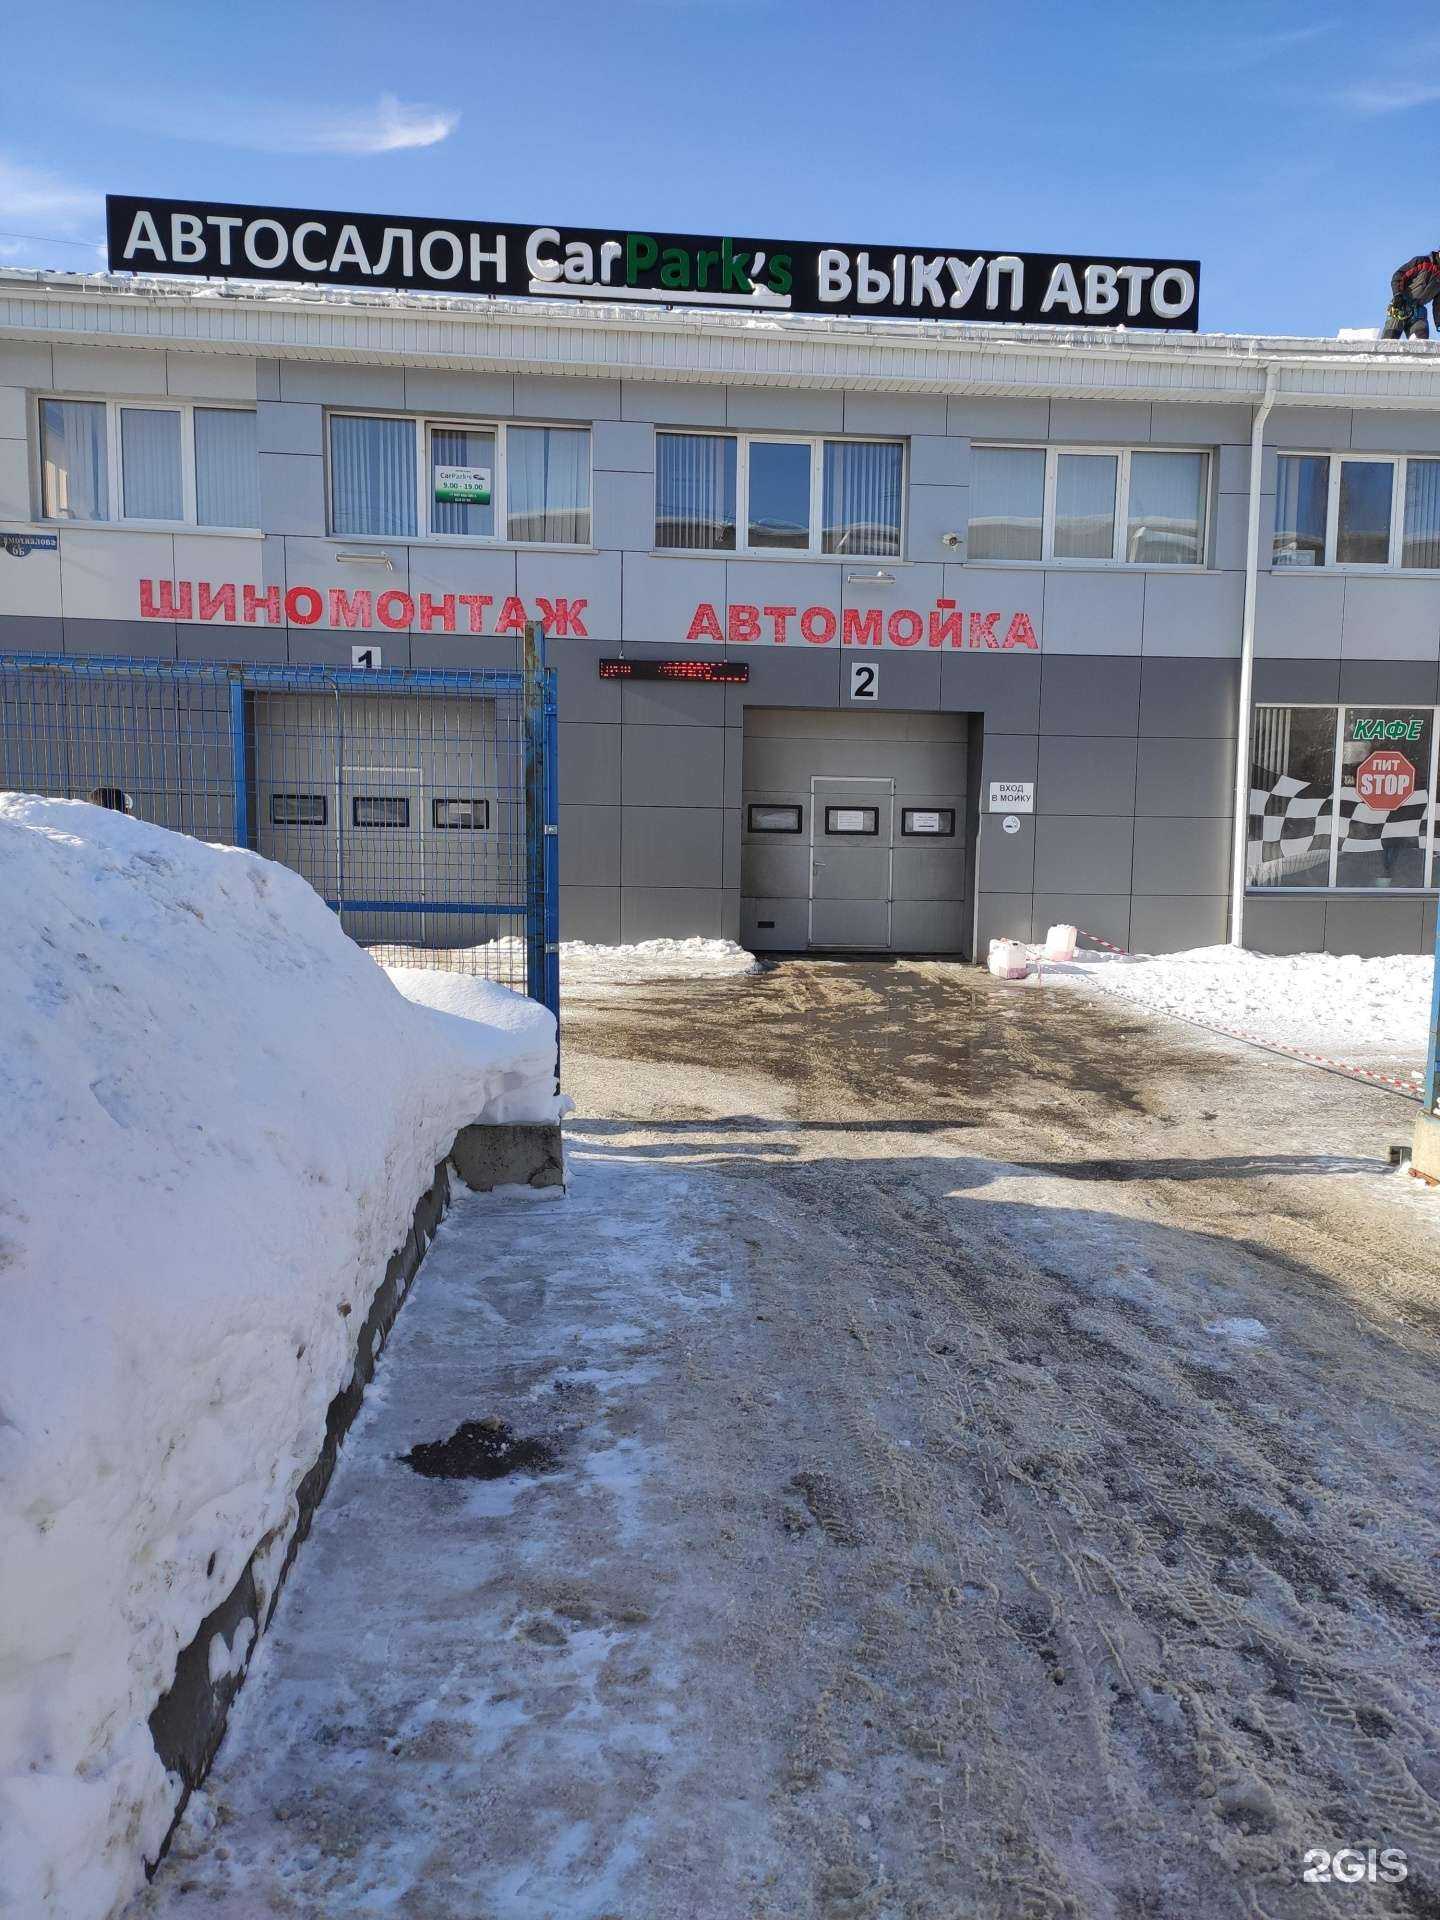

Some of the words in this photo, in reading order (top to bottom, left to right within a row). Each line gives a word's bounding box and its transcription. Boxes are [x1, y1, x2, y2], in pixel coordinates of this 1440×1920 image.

[122, 210, 507, 284] АВТОСАЛОН
[816, 249, 1025, 312] ВЫКУП
[1040, 262, 1196, 319] АВТО
[139, 579, 588, 640] ШИНОМОНТАЖ
[686, 599, 1040, 650] АВТОМОЙКА
[358, 650, 372, 668] 1
[855, 666, 875, 697] 2
[1353, 718, 1424, 741] КАФЕ
[1372, 759, 1401, 771] ПИТ
[999, 784, 1024, 793] ВХОД
[1361, 774, 1410, 796] STOP
[991, 794, 998, 802] В
